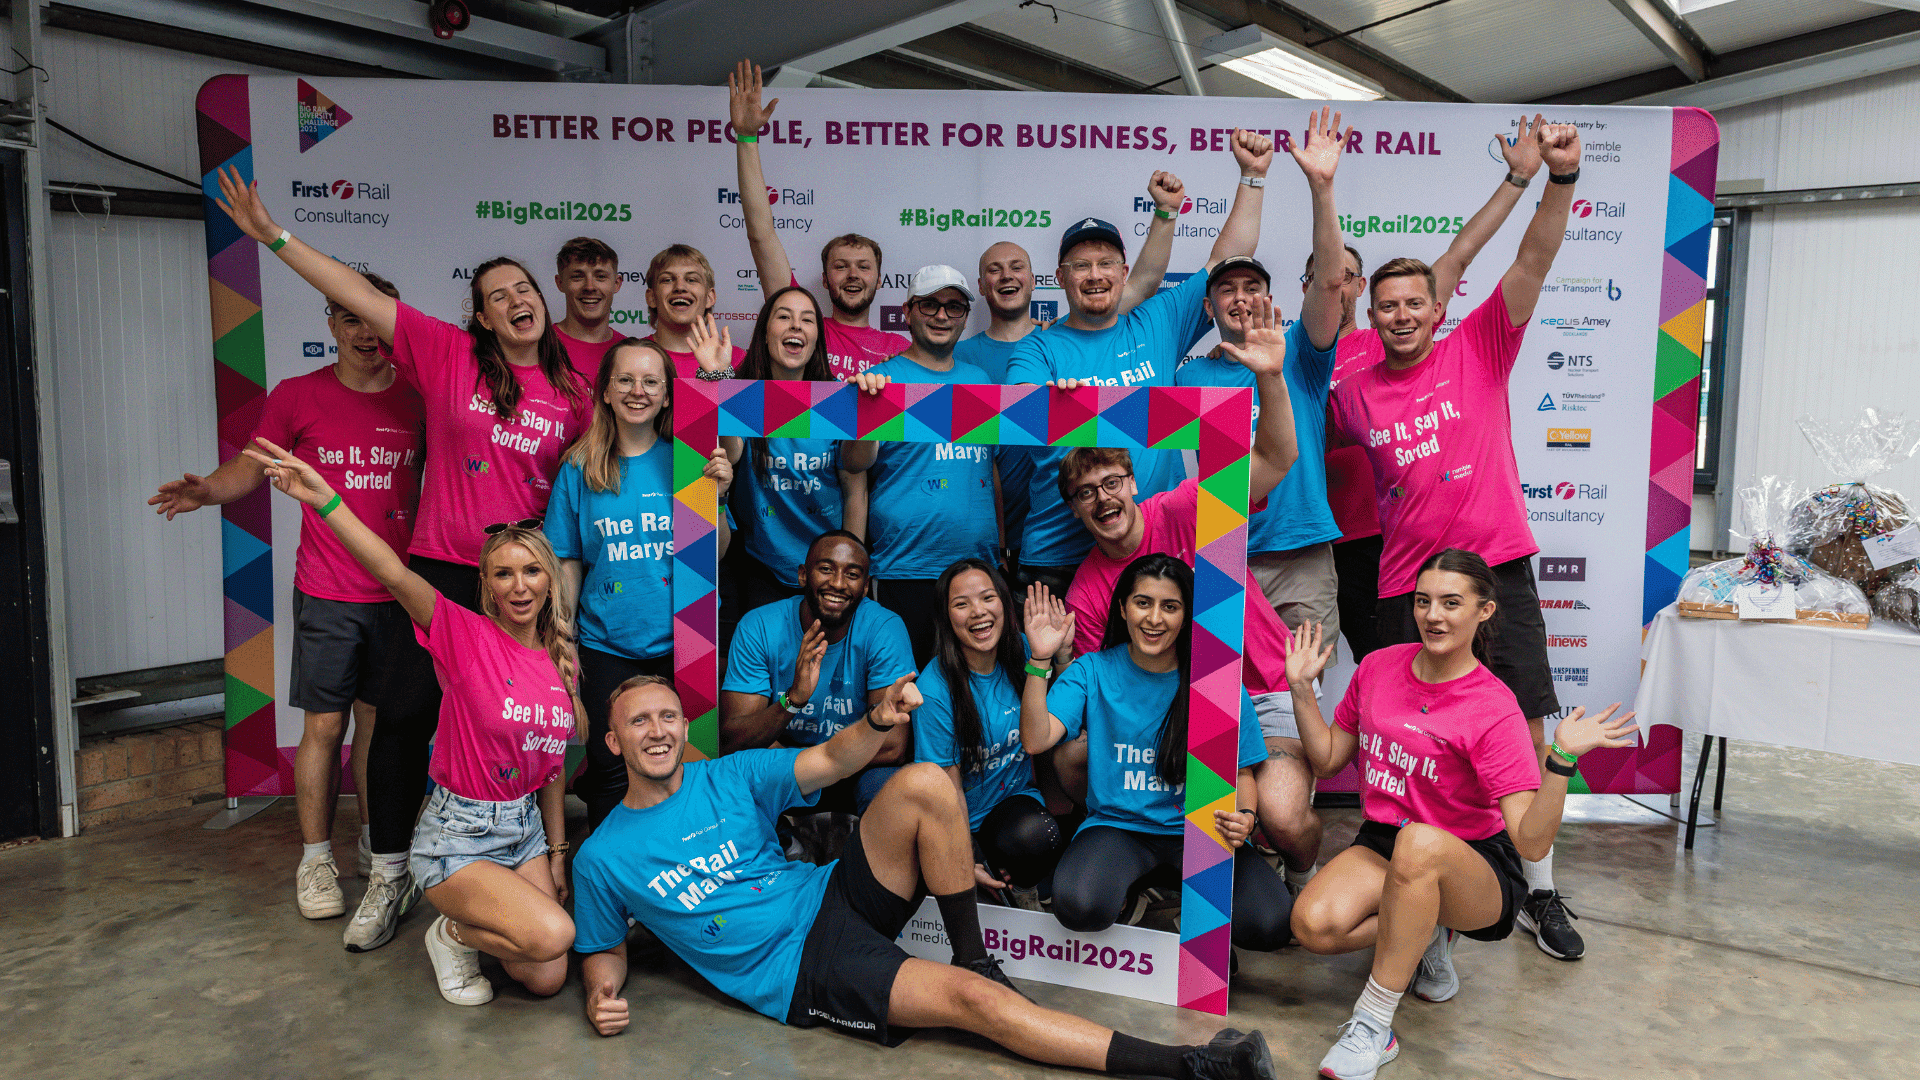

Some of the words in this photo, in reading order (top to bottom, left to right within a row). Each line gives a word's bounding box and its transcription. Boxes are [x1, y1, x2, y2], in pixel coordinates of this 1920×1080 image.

[299, 112, 334, 120] DIVERSITY
[299, 119, 339, 127] CHALLENGE
[1595, 119, 1608, 130] by:
[493, 114, 600, 140] BETTER
[612, 117, 675, 142] FOR
[825, 121, 930, 146] BETTER
[942, 122, 1004, 147] FOR
[1016, 123, 1178, 155] BUSINESS,
[1375, 130, 1441, 156] RAIL
[1585, 141, 1622, 152] nimble
[1584, 153, 1620, 163] media
[292, 181, 329, 198] First
[358, 183, 390, 200] Rail
[782, 188, 814, 205] Rail
[475, 200, 632, 225] #BigRail2025
[1196, 197, 1227, 214] Rail
[1596, 202, 1626, 218] Rail
[294, 208, 389, 228] Consultancy
[719, 214, 813, 233] Contancy
[899, 207, 1052, 232] #BigRail2025
[1338, 214, 1464, 238] BigRail2025
[1564, 227, 1623, 244] sultancy
[1540, 284, 1560, 292] etter
[1563, 284, 1602, 294] Transport
[1555, 276, 1591, 285] Campaign
[1582, 316, 1611, 328] Amey
[1568, 355, 1593, 367] NTS
[1120, 360, 1156, 386] Rail
[1562, 403, 1587, 411] Risktec
[469, 393, 497, 415] See
[521, 409, 552, 437] Slay
[554, 421, 566, 443] It,
[1369, 428, 1391, 448] See
[1394, 421, 1412, 442] It,
[1440, 400, 1461, 420] It,
[491, 424, 541, 455] Sorted
[317, 446, 344, 464] See
[349, 446, 365, 467] It,
[370, 446, 401, 469] Slay
[935, 442, 988, 463] Marys
[1395, 434, 1440, 467] Sorted
[794, 452, 831, 471] Rail
[345, 470, 392, 490] Sorted
[927, 479, 948, 489] WR
[1579, 483, 1607, 500] Rail
[594, 517, 634, 538] The
[641, 513, 674, 532] Ra
[1546, 564, 1579, 574] EMR
[603, 581, 623, 594] WR
[1547, 634, 1588, 648] ilnews
[1550, 666, 1589, 675] RANSPENNINE
[502, 697, 531, 723] See
[535, 703, 548, 729] It,
[1113, 743, 1156, 764] The
[1370, 733, 1384, 761] It,
[1388, 741, 1418, 776] Slay
[1421, 756, 1439, 783] It,
[1365, 760, 1406, 797] Sorted
[647, 863, 693, 898] The
[689, 839, 739, 873] Rail
[704, 914, 727, 937] WR
[981, 927, 1154, 975] BigRail2025
